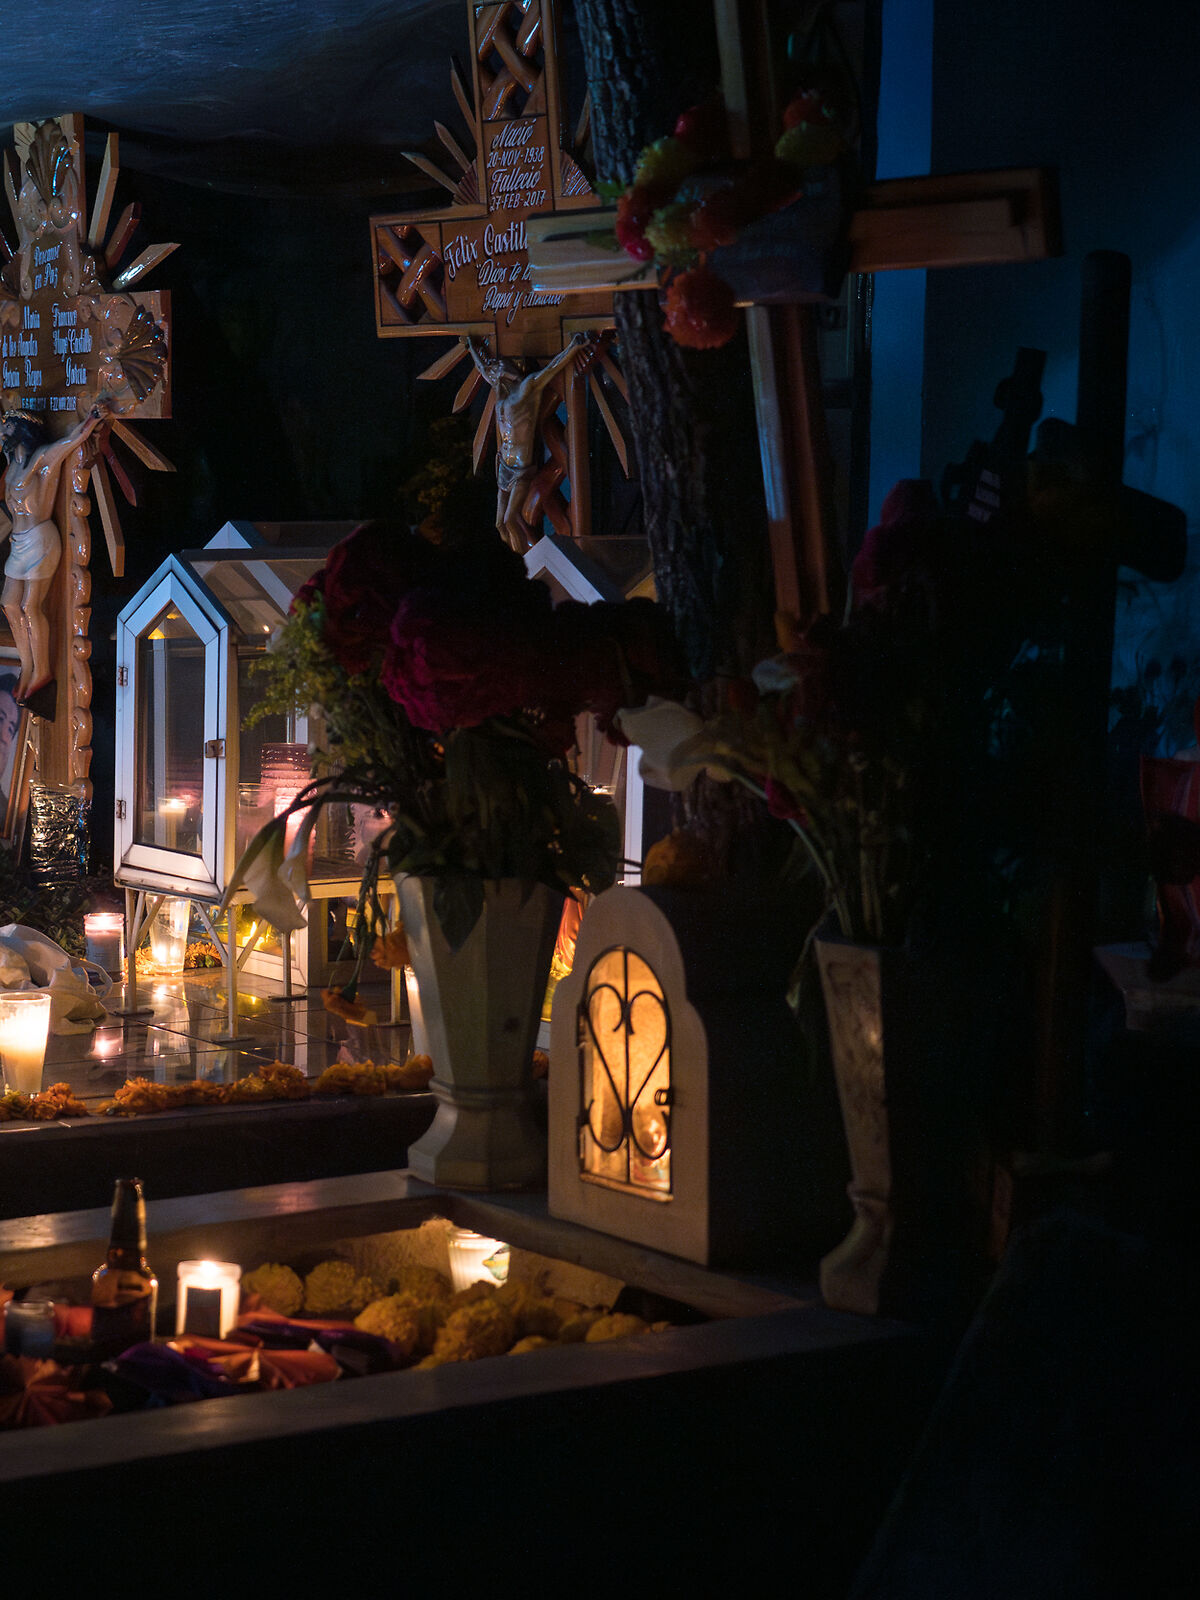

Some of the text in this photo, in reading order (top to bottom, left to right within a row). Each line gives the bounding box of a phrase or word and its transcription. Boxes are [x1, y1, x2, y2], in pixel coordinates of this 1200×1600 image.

[491, 118, 537, 150] Nació
[491, 164, 544, 195] Falleció
[443, 235, 478, 278] Félix
[509, 263, 522, 282] te
[506, 291, 522, 325] y
